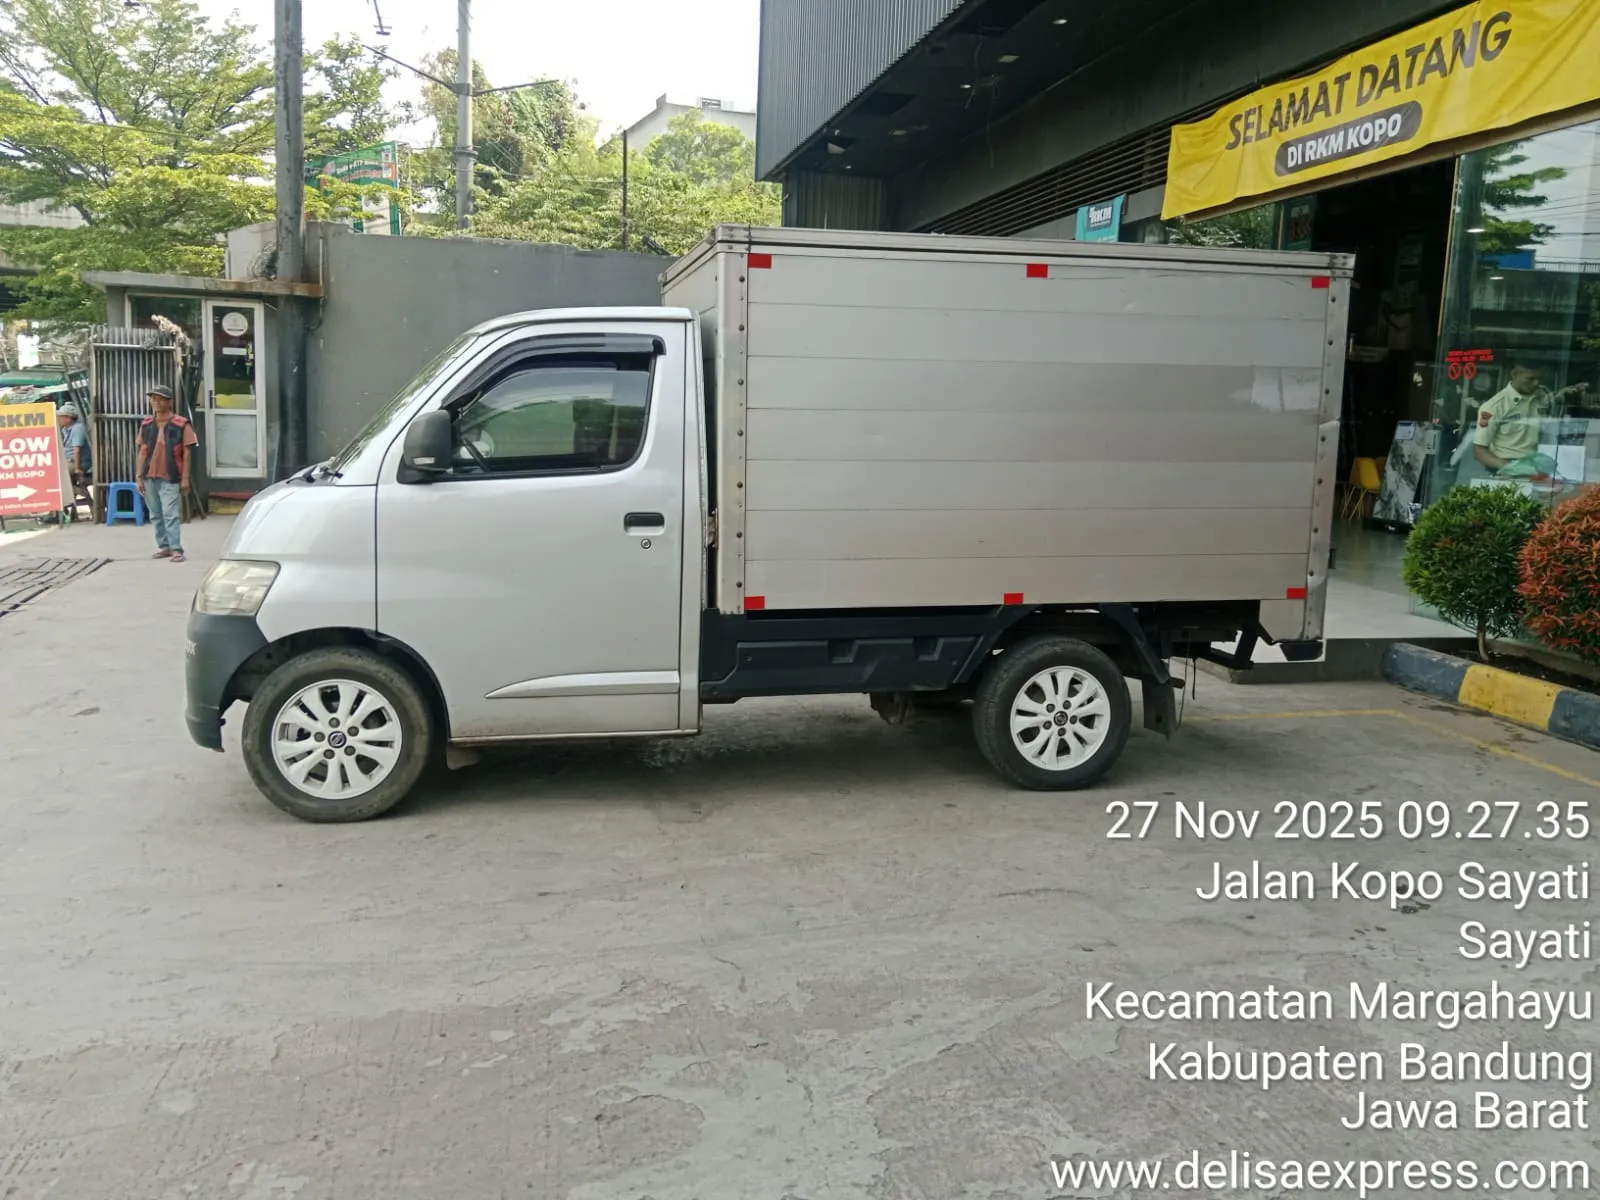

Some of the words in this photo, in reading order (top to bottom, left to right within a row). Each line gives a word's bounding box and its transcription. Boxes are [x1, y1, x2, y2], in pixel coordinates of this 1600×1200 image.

[1225, 71, 1351, 151] SELAMAT
[1355, 11, 1513, 108] DATANG
[1286, 144, 1303, 169] DI
[1304, 130, 1345, 163] RKM
[1346, 113, 1402, 151] KOPO
